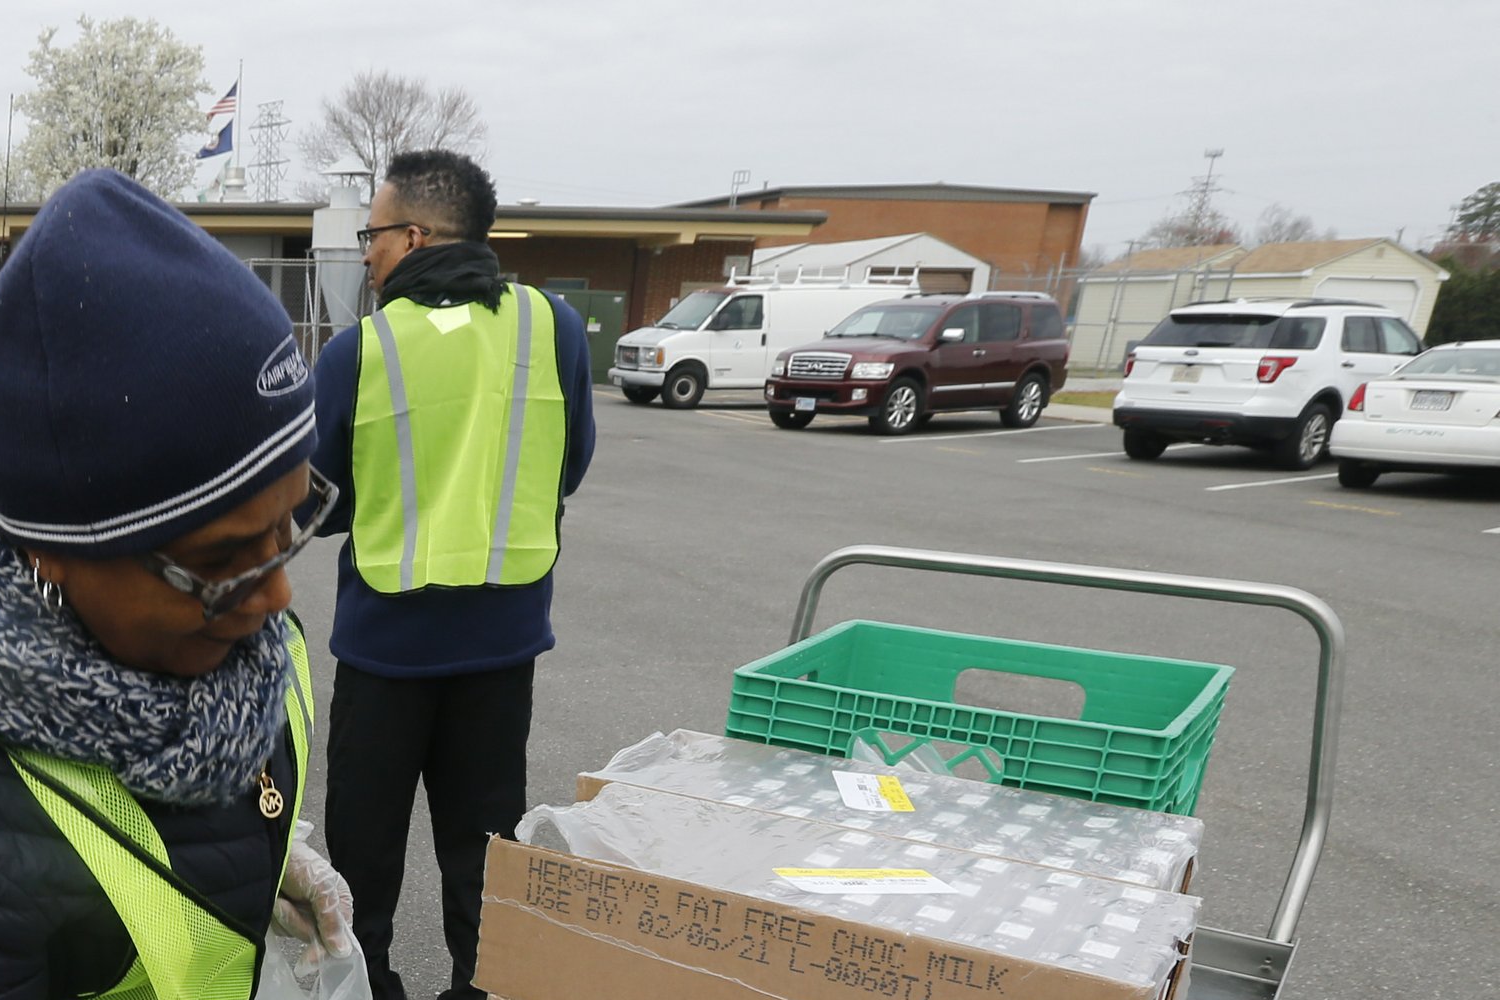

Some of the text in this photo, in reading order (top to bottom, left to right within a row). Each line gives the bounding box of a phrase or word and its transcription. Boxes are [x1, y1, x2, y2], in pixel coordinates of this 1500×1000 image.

[262, 795, 281, 812] MK
[526, 882, 571, 914] USE
[586, 897, 622, 925] BY:
[527, 857, 1009, 994] HERSHEY'S FAT FREE CHOC MILK
